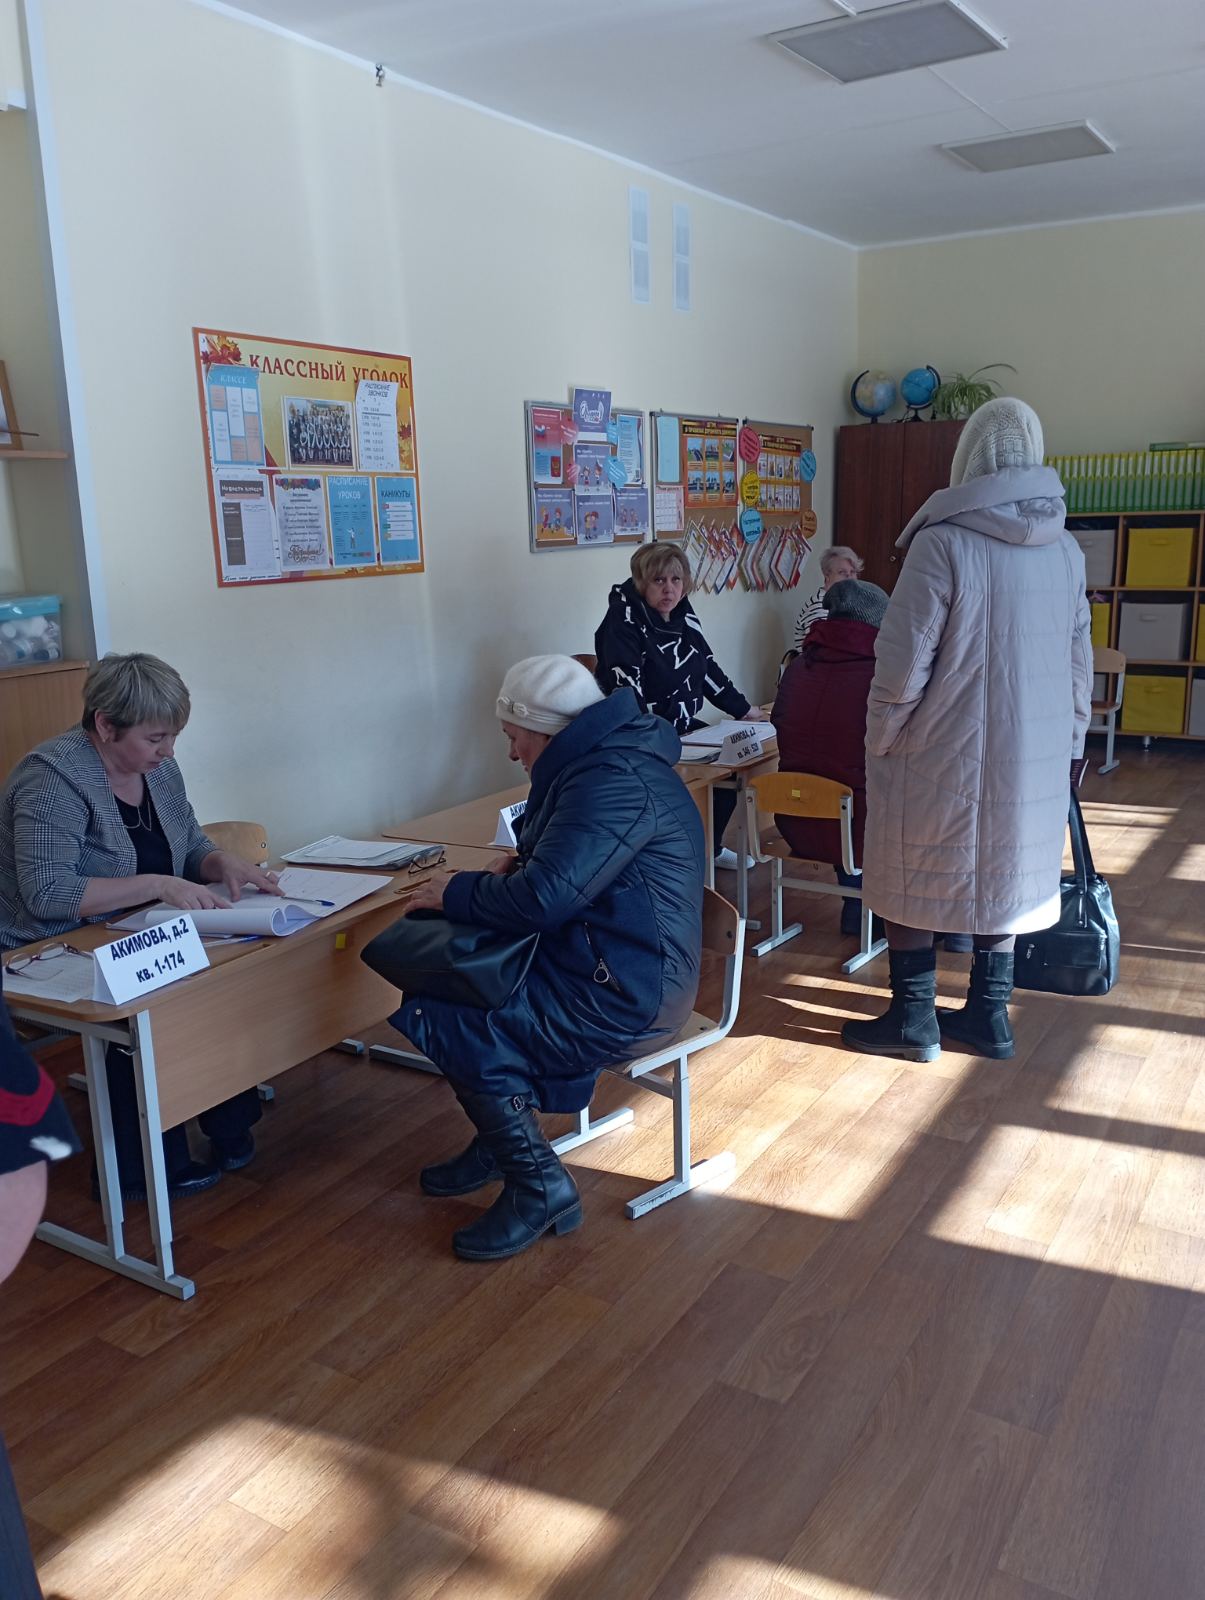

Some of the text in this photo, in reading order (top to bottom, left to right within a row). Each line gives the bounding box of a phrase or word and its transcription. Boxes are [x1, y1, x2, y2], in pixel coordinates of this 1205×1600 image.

[249, 354, 409, 389] КЛАССНЫЙ УГОЛОК
[110, 918, 190, 961] АКИМОВА, д.2
[135, 949, 186, 983] кв. 1-174
